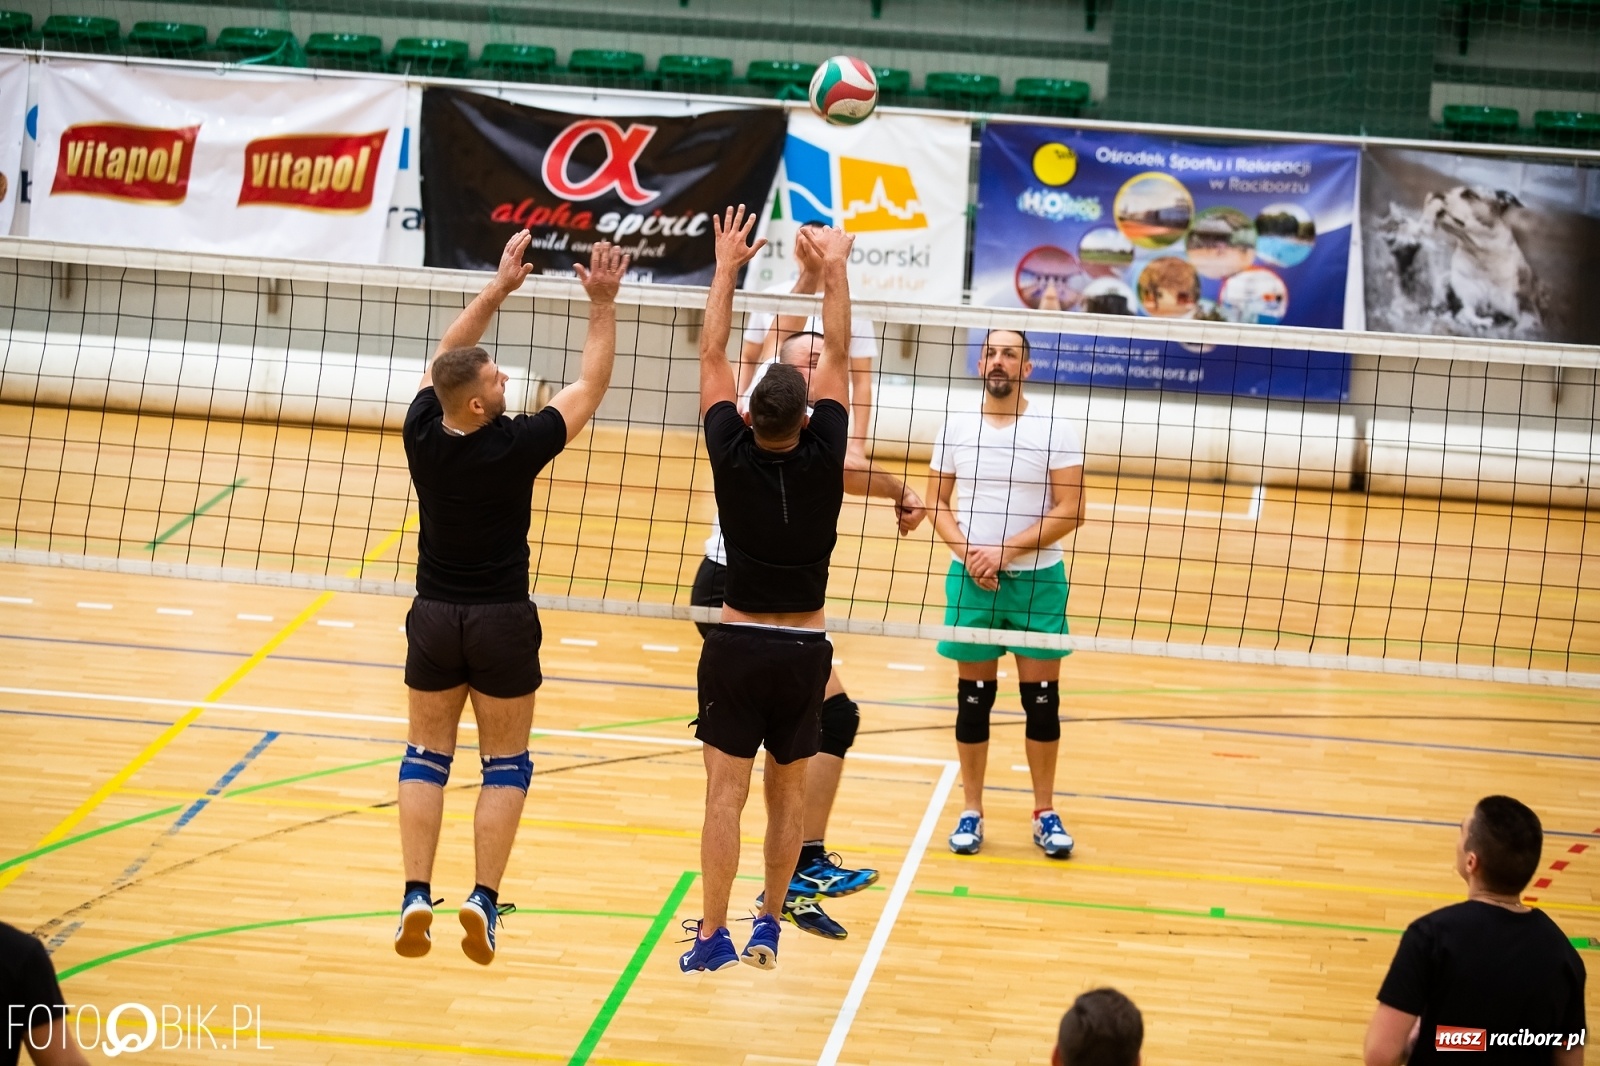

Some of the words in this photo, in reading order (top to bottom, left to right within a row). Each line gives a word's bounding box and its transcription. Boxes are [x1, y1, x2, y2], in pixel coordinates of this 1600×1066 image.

[66, 139, 184, 184] Vitapol
[252, 146, 371, 194] Vitapol
[1096, 146, 1166, 168] Ośrodek
[1169, 153, 1223, 172] Sportu
[1226, 158, 1233, 171] i
[1235, 158, 1312, 177] Rekreacji
[1209, 179, 1225, 190] w
[1229, 177, 1310, 194] Raciborzu
[490, 198, 594, 230] alpha
[596, 209, 709, 242] spirit
[532, 231, 570, 251] wild
